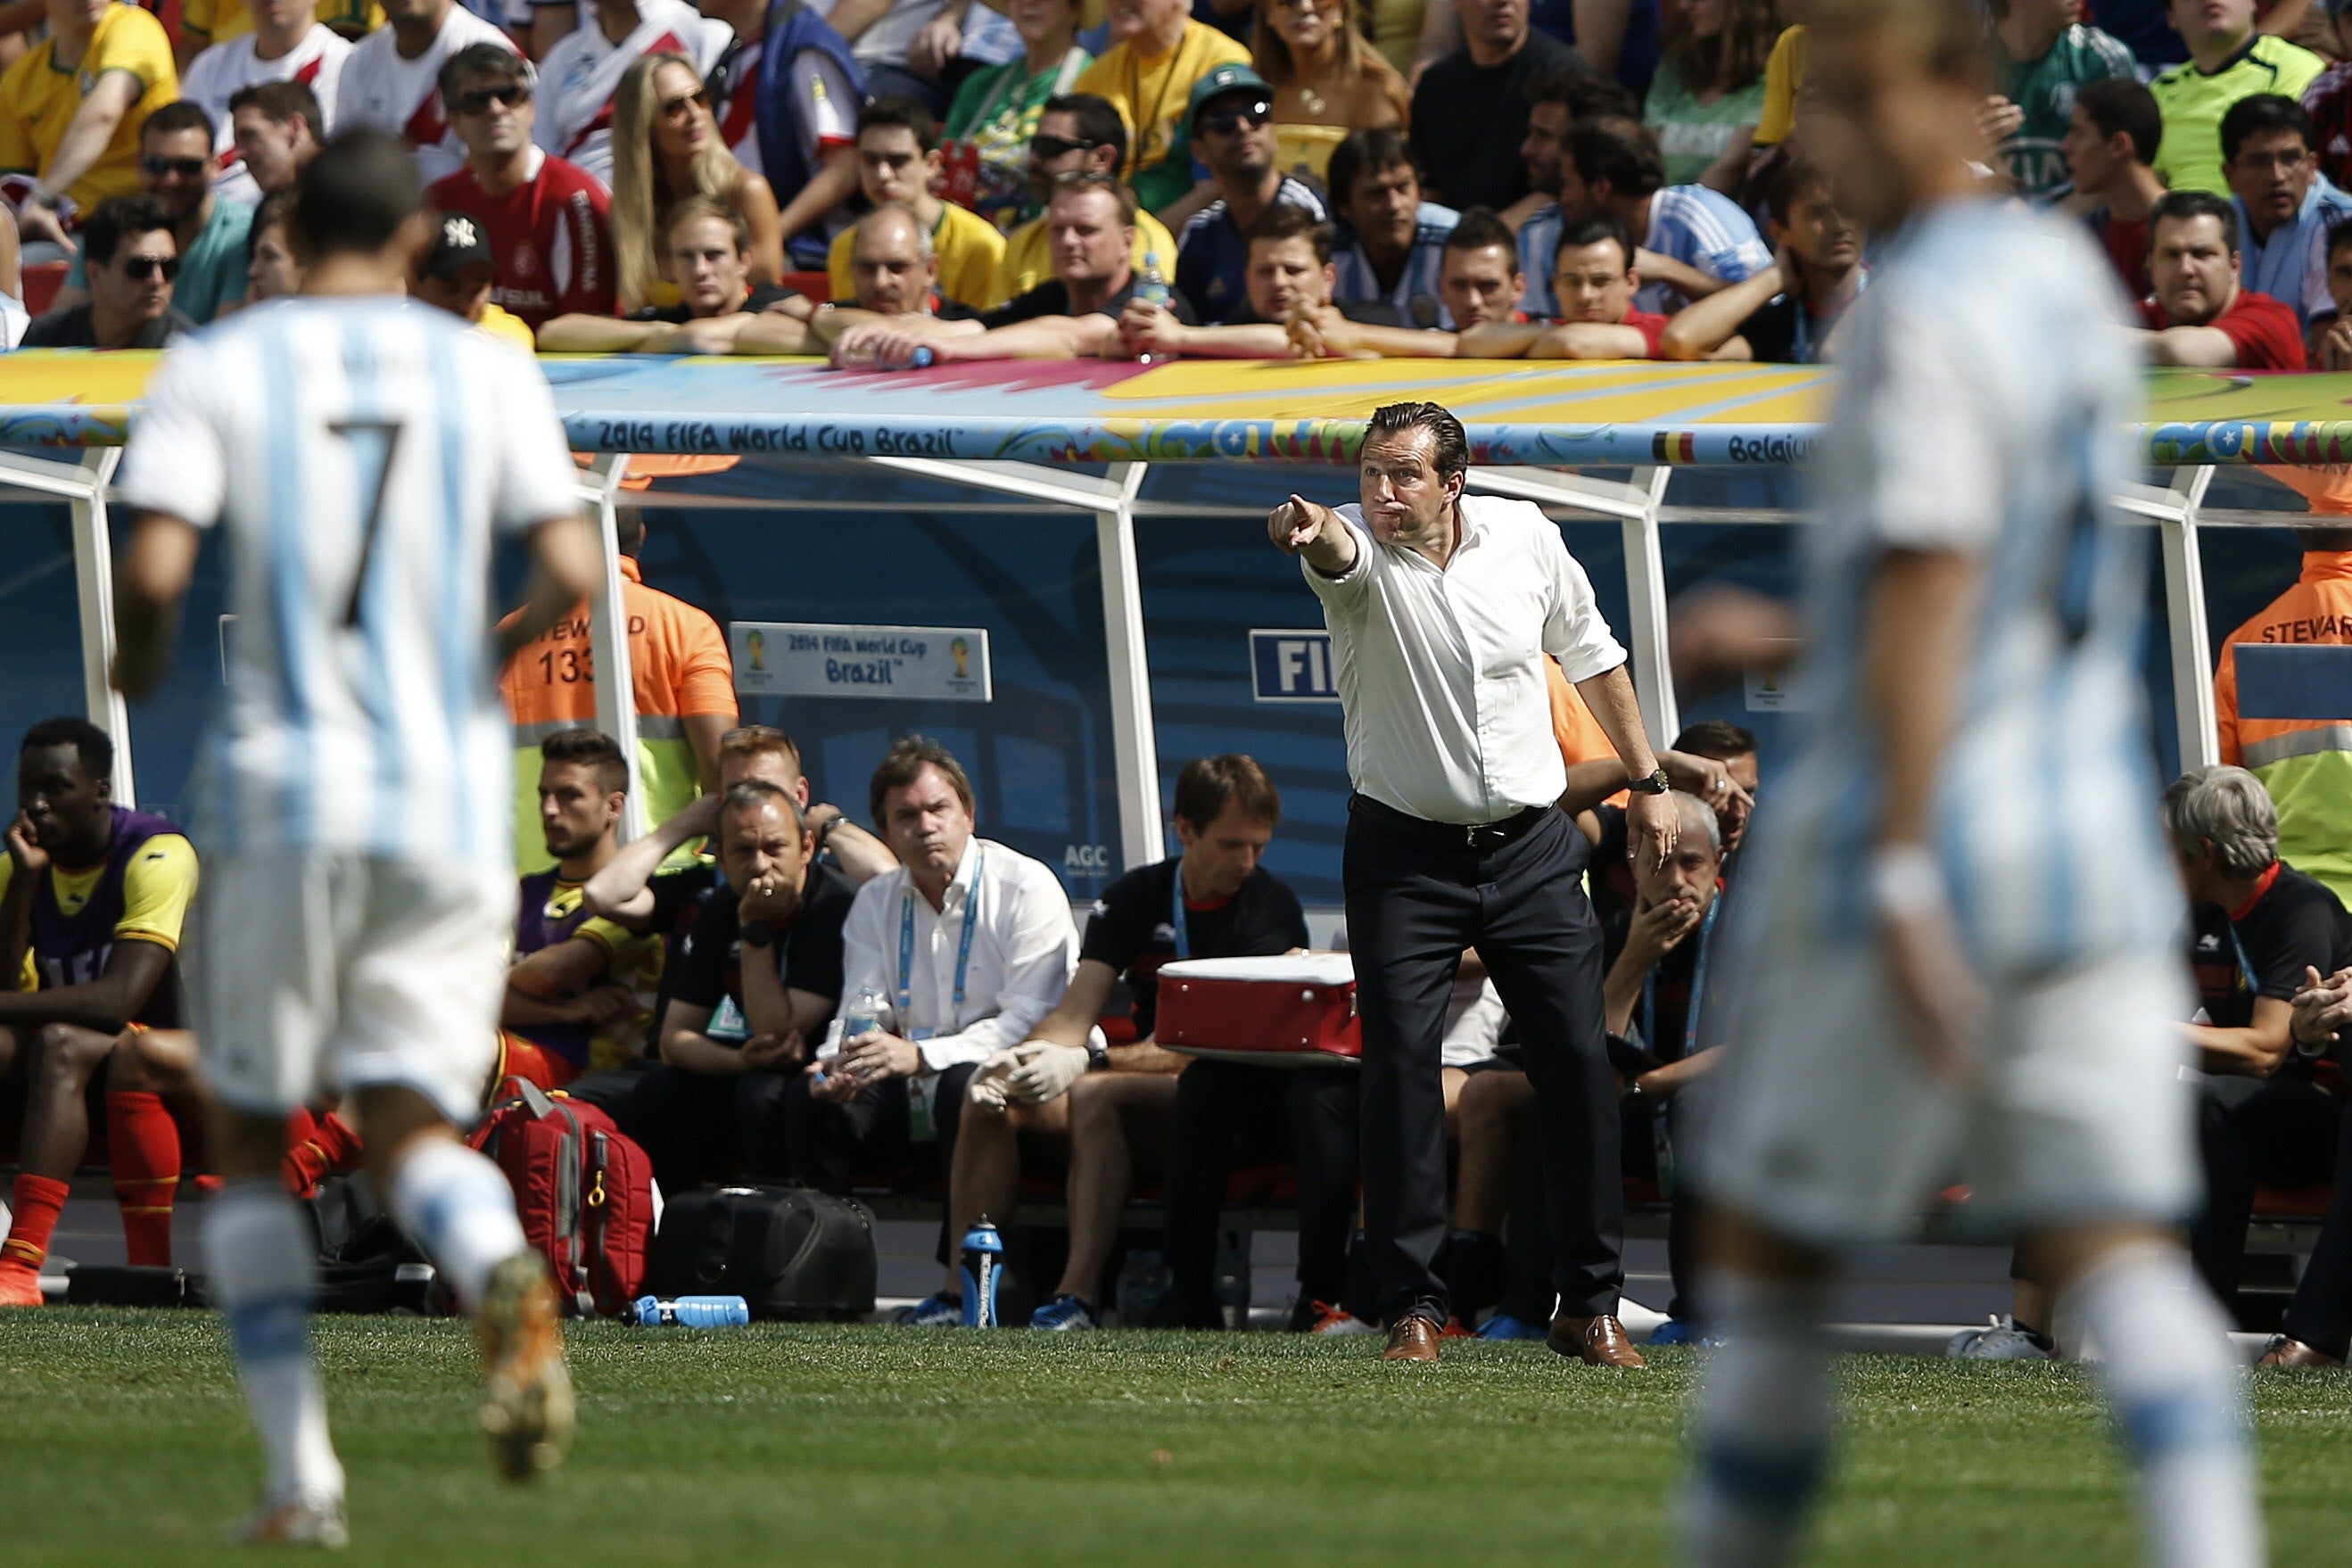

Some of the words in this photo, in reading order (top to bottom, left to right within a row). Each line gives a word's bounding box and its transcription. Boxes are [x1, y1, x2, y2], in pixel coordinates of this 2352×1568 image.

[598, 420, 656, 450] 2014
[666, 420, 720, 449] FIFA
[729, 423, 809, 452] World
[817, 424, 865, 455] Cup
[325, 417, 405, 631] 7
[2261, 614, 2352, 643] STEWAR
[788, 633, 820, 652] 2014
[823, 634, 852, 653] FIFA
[855, 635, 896, 655] World
[899, 638, 927, 659] Cup
[1277, 640, 1338, 692] FI
[1064, 844, 1110, 866] AGC
